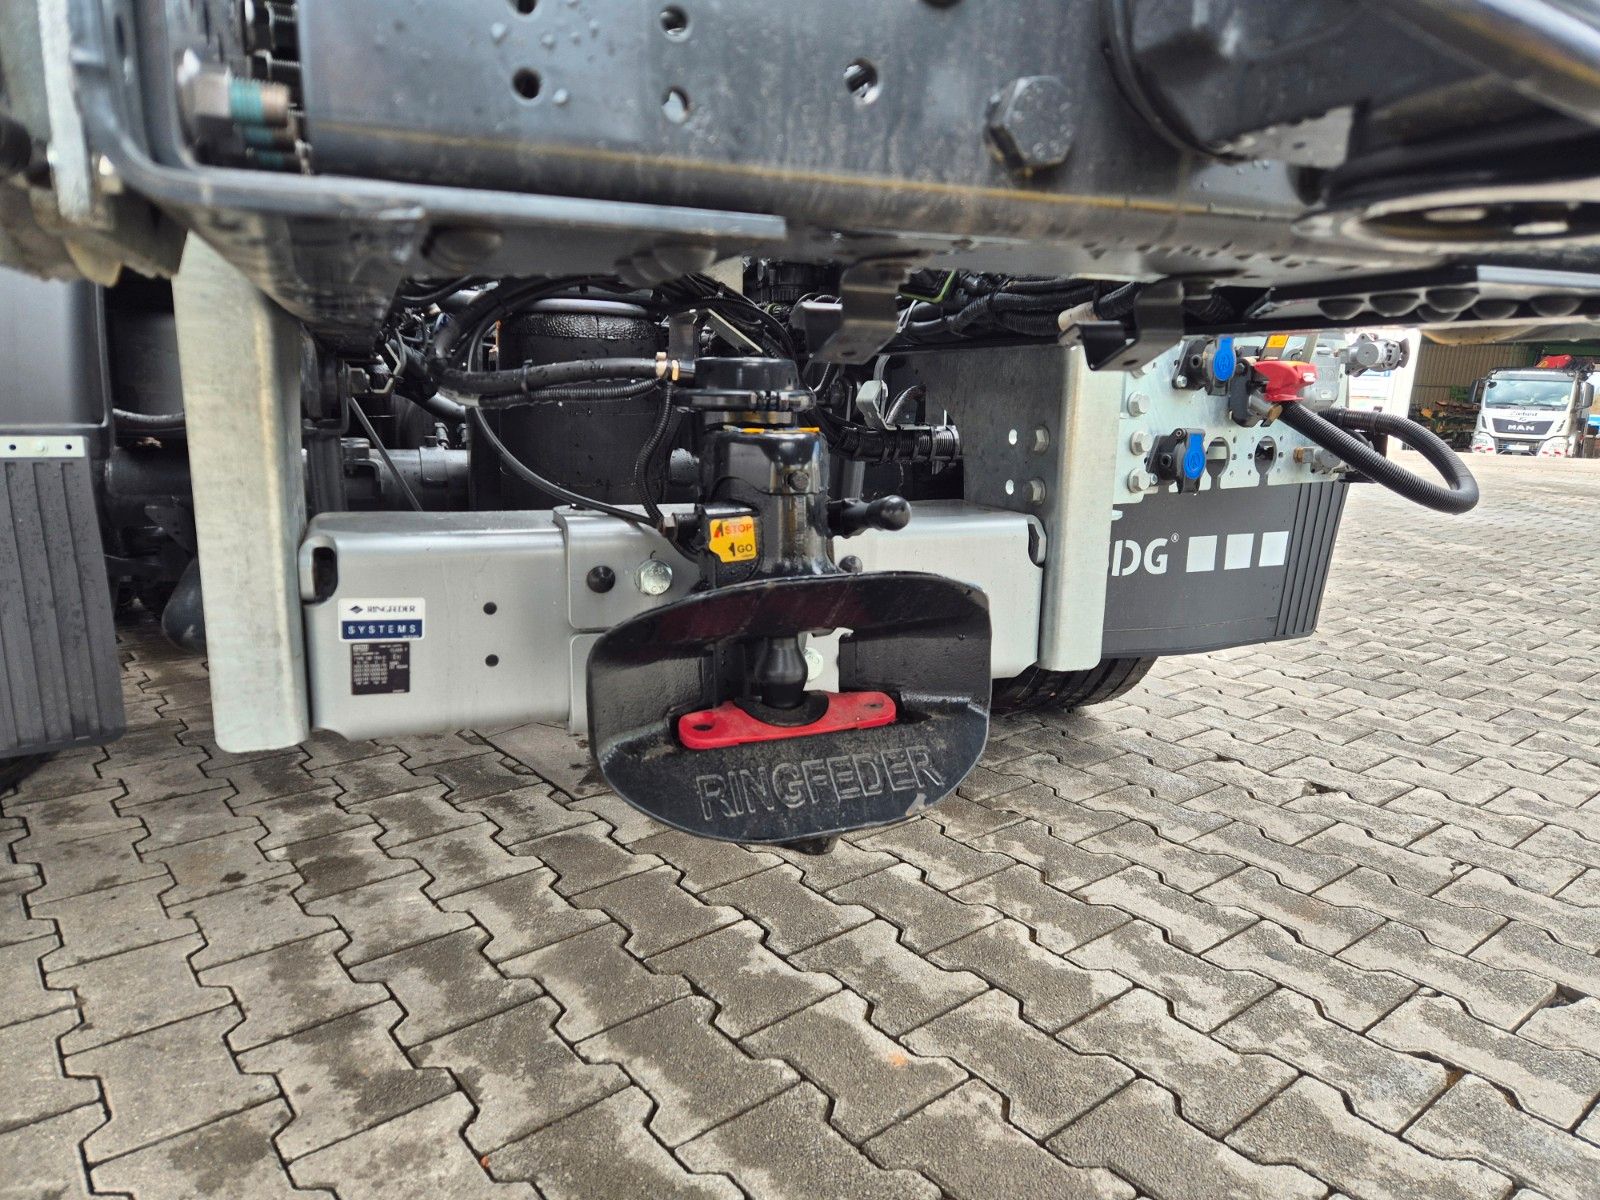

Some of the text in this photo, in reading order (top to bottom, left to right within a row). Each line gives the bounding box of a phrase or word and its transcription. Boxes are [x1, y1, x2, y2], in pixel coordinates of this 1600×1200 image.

[725, 523, 752, 534] STOP
[737, 543, 753, 553] GO
[347, 624, 417, 635] SYSTEMS
[695, 744, 946, 821] RINGFEDER
